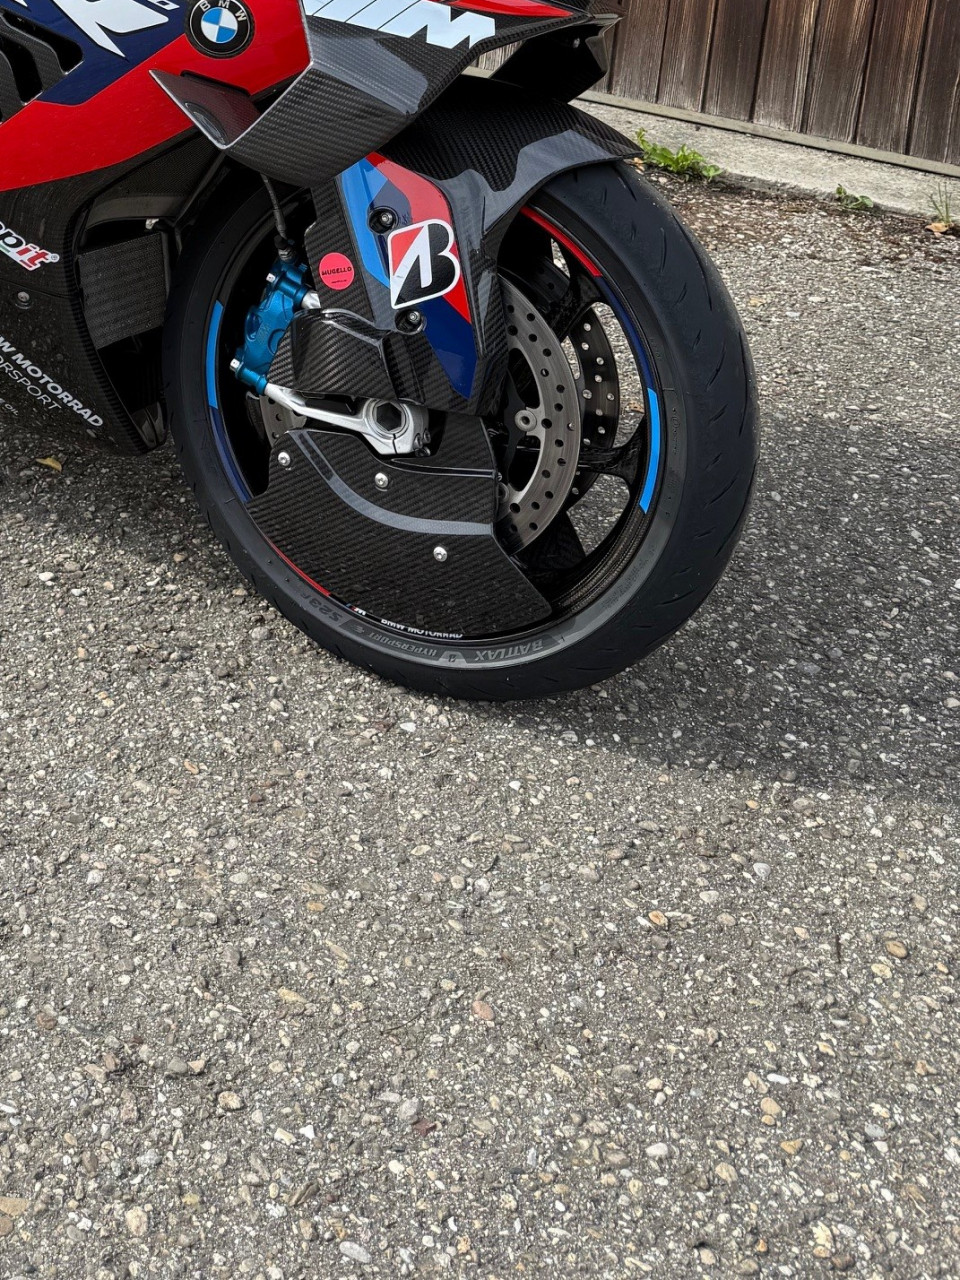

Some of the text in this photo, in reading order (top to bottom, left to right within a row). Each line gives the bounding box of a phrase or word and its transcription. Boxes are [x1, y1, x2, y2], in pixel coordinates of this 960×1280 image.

[321, 266, 352, 276] MUGELLO
[11, 353, 104, 428] MOTORRAD
[4, 403, 19, 416] OIL
[368, 632, 437, 657] HYPERSPORT
[474, 639, 544, 662] BATTLAX
